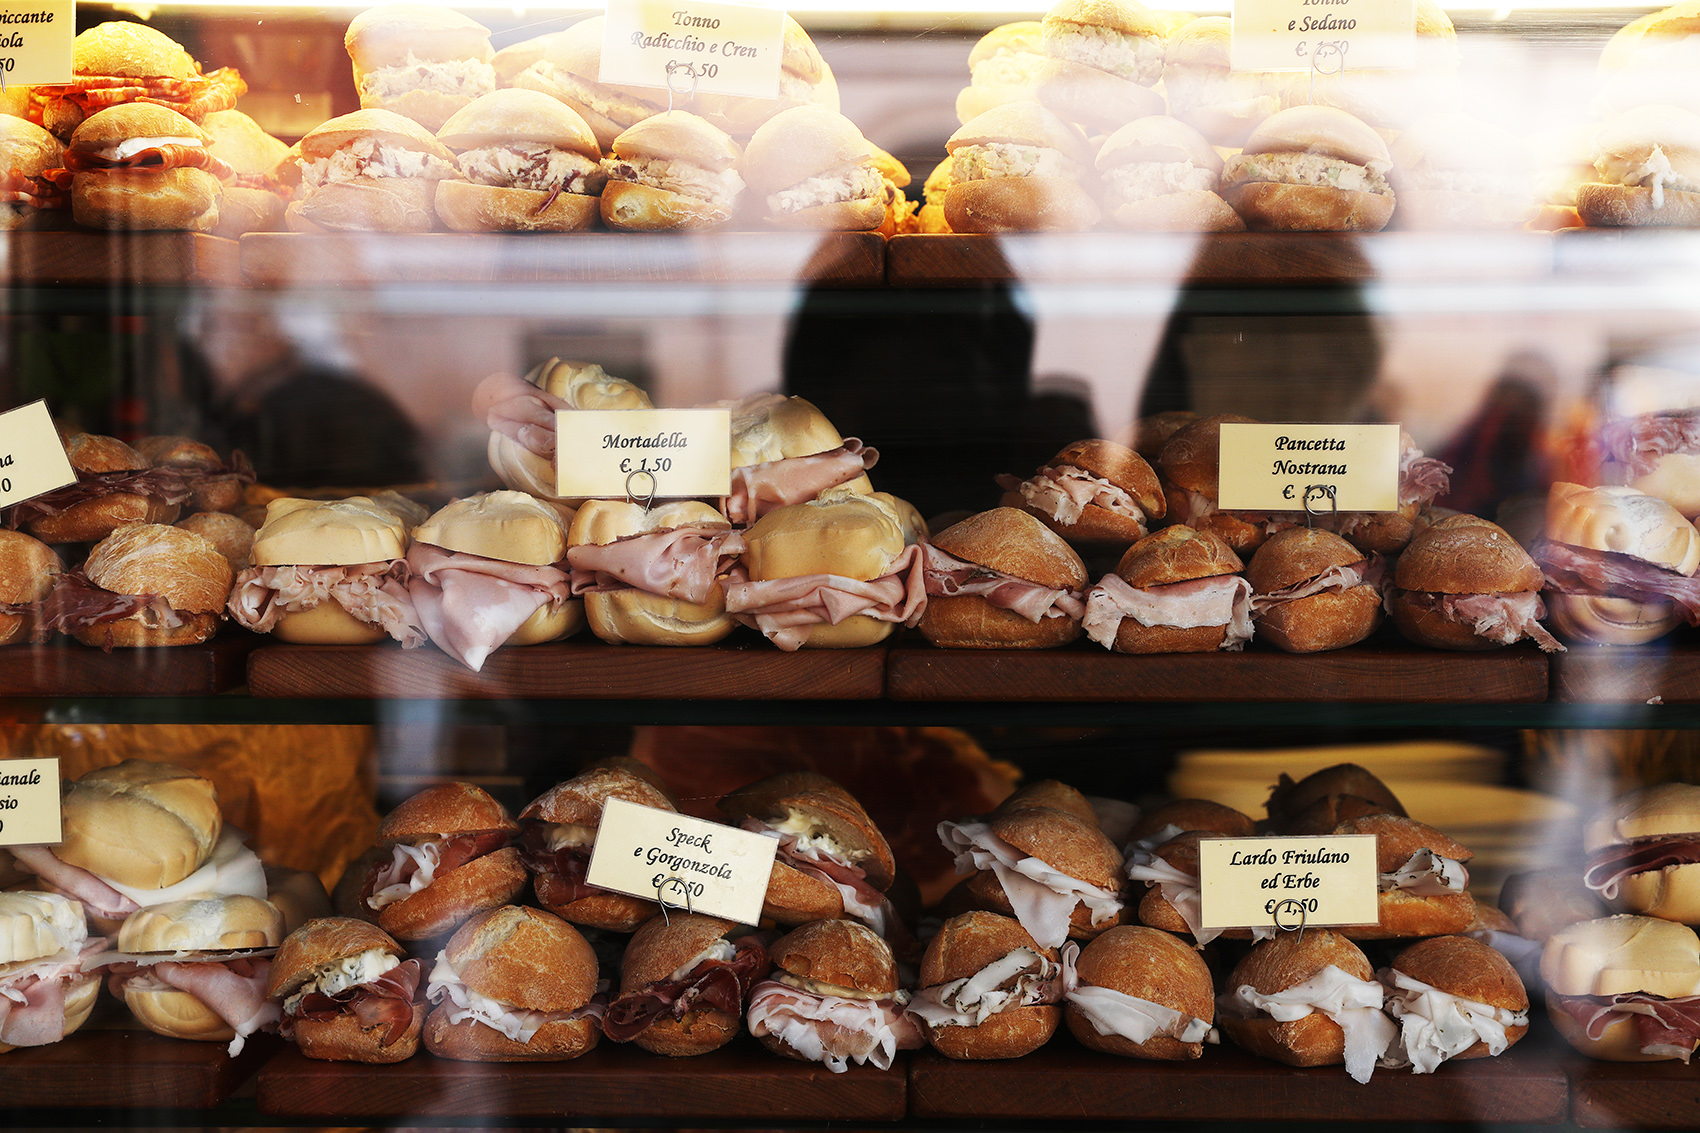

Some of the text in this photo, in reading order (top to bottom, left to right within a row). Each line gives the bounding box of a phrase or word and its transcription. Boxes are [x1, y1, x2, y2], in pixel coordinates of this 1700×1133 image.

[672, 10, 721, 29] Tonno
[1288, 13, 1357, 32] e Sedano
[630, 31, 758, 58] Radicchio e Cren
[602, 431, 688, 449] Mortadella
[1274, 436, 1346, 451] Pancetta
[1271, 460, 1348, 476] Nostrana
[0, 477, 12, 493] 0
[666, 827, 713, 854] Speck
[633, 846, 733, 881] e Gorgonzola
[1229, 847, 1351, 867] Lardo Friulano
[1261, 872, 1321, 889] ed Erbe
